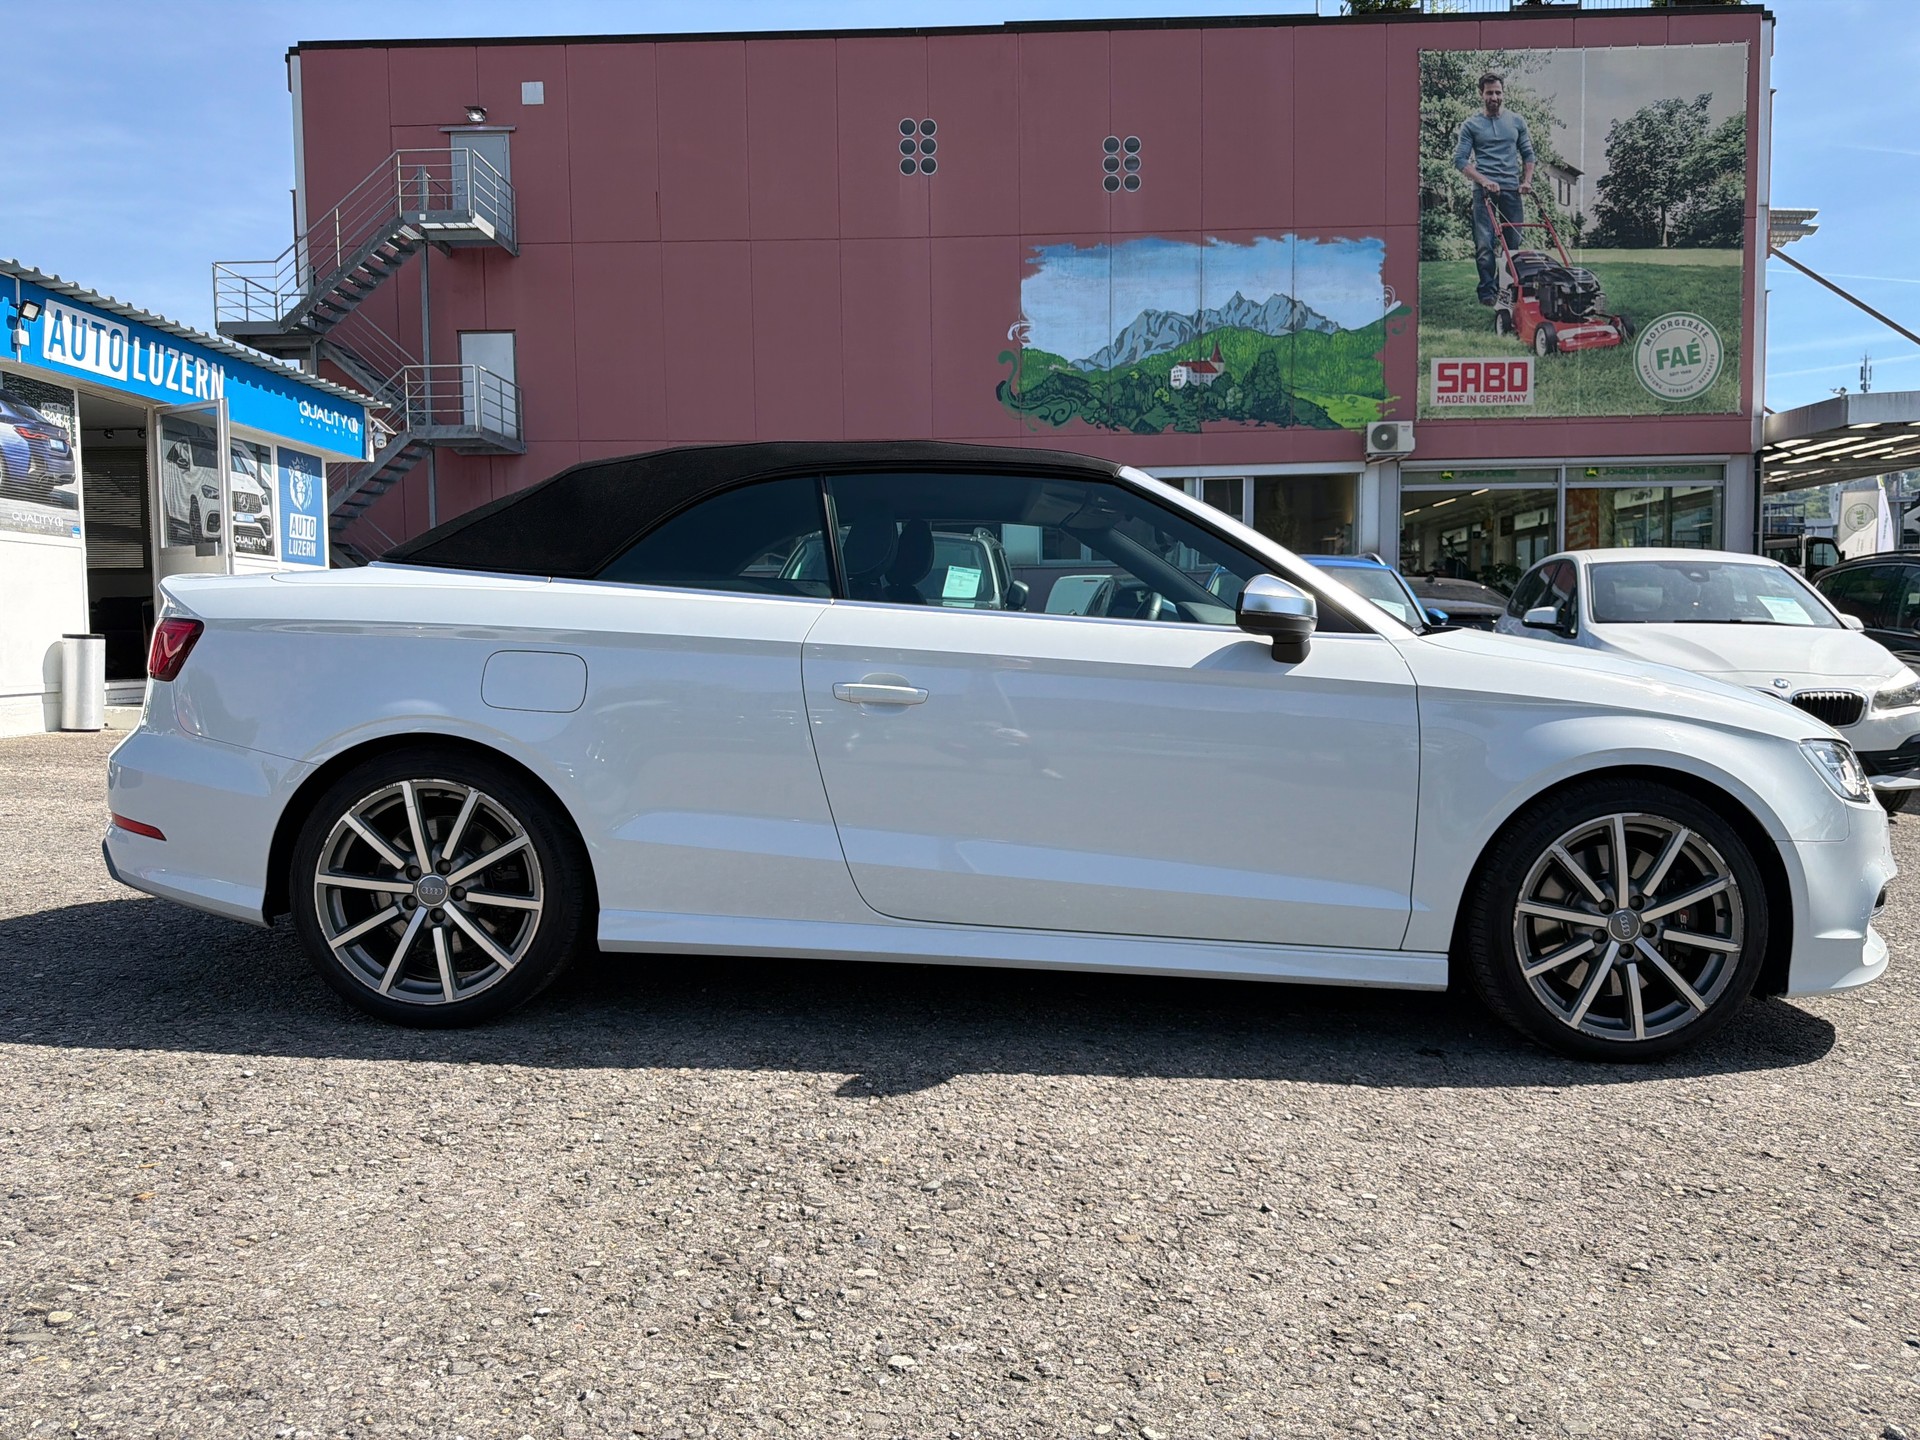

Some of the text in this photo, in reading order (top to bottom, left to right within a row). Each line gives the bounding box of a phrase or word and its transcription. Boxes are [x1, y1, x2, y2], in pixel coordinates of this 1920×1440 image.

[1656, 337, 1702, 371] FAÉ
[1437, 362, 1528, 393] SABO
[1437, 394, 1528, 404] MADE IN GERMANY
[290, 516, 315, 538] AUTO
[288, 539, 316, 558] LUZERN
